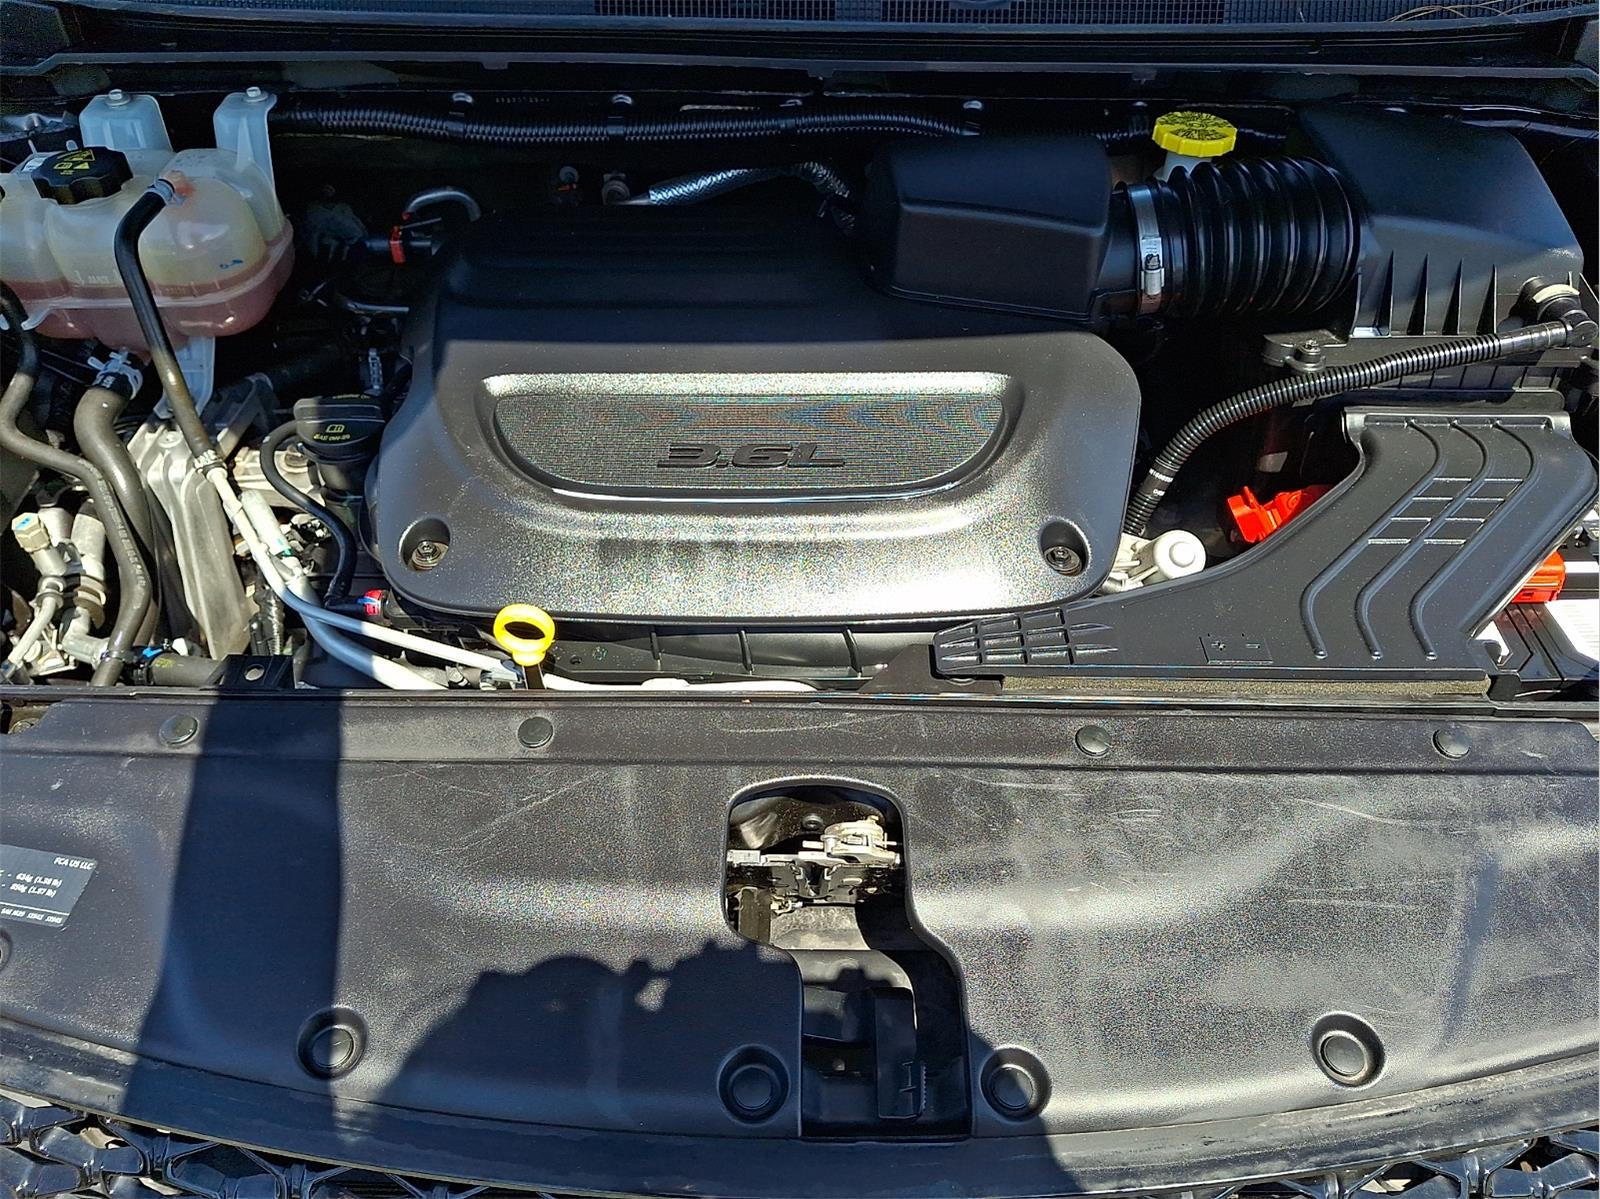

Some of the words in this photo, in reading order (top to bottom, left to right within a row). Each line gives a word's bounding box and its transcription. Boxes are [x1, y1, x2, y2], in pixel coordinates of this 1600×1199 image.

[657, 442, 846, 468] 3.6L
[54, 857, 68, 866] FCA
[69, 859, 79, 868] US
[80, 861, 94, 870] LLC
